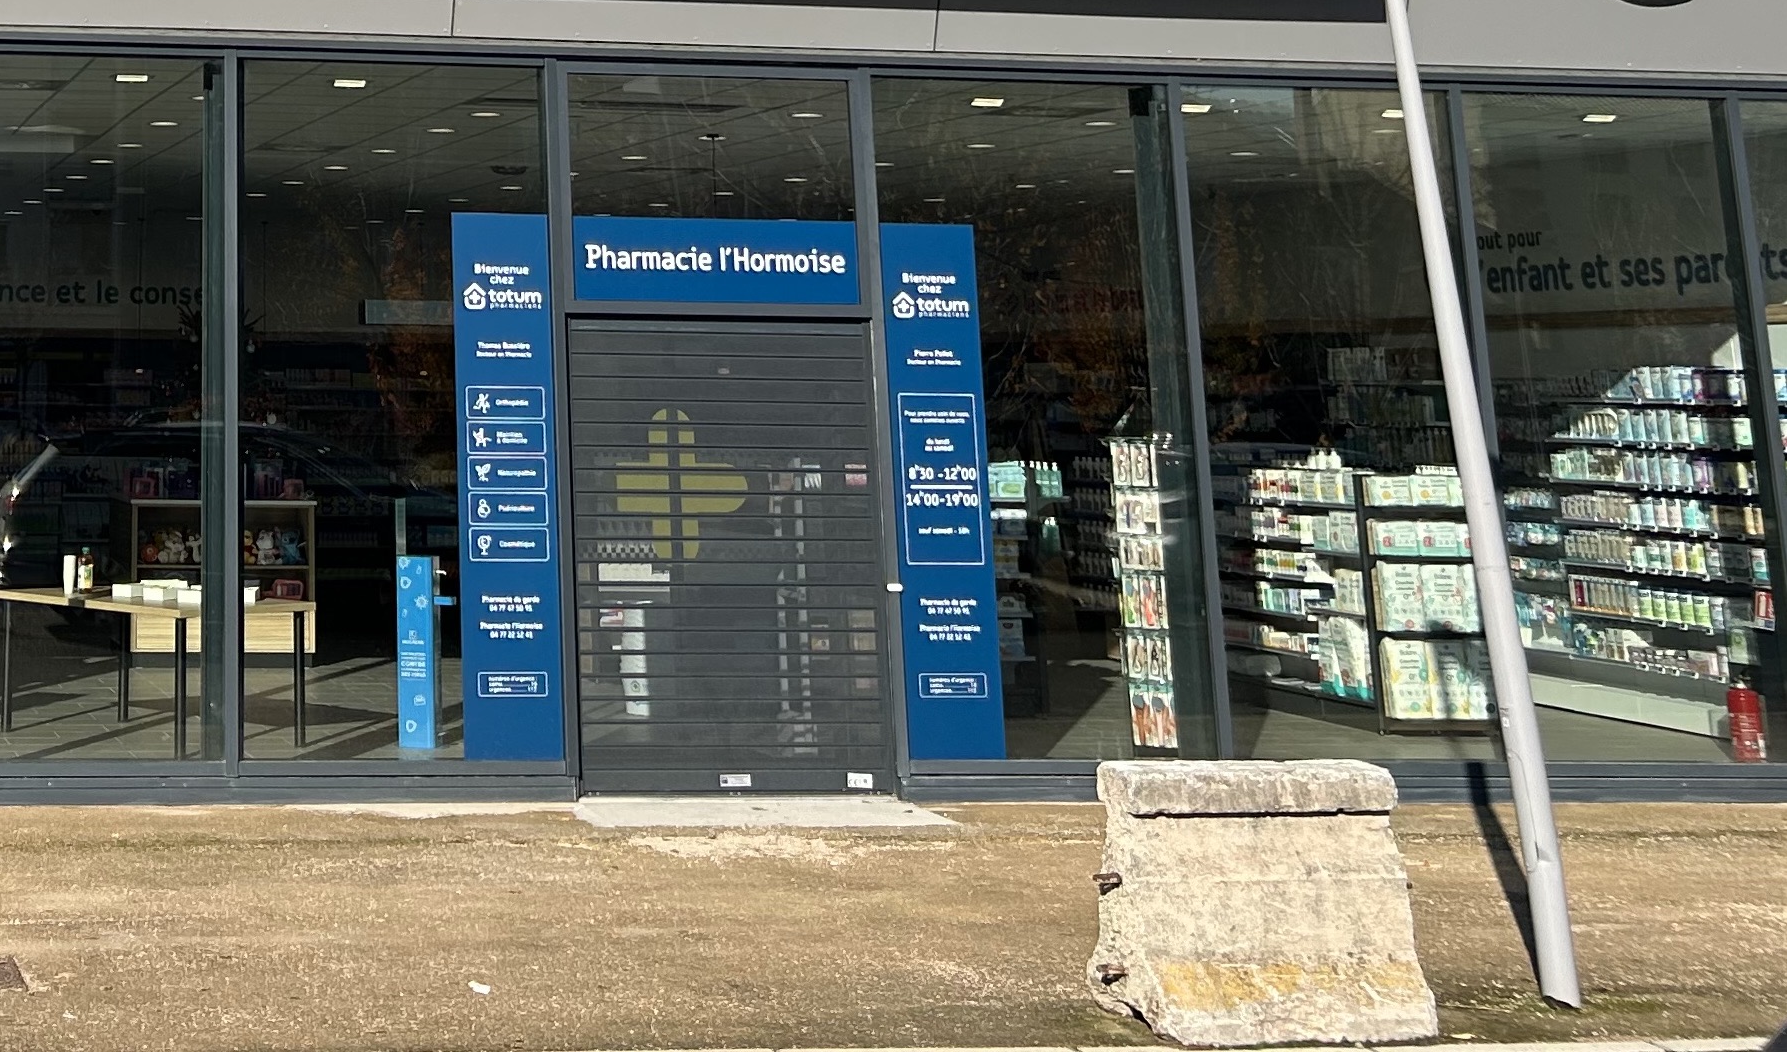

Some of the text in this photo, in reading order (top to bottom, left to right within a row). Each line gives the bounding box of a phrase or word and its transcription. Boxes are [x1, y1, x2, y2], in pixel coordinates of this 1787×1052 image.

[1477, 231, 1542, 253] out pour
[584, 244, 846, 274] Pharmacie l'Hormoise
[473, 263, 530, 275] Bienvenue
[1478, 243, 1787, 296] 'enfant et ses parts
[489, 275, 514, 285] chez
[901, 272, 956, 284] Bienvenue
[56, 281, 86, 304] et
[96, 279, 120, 304] le
[488, 289, 542, 303] totum
[917, 284, 942, 294] chez
[916, 298, 969, 312] totum
